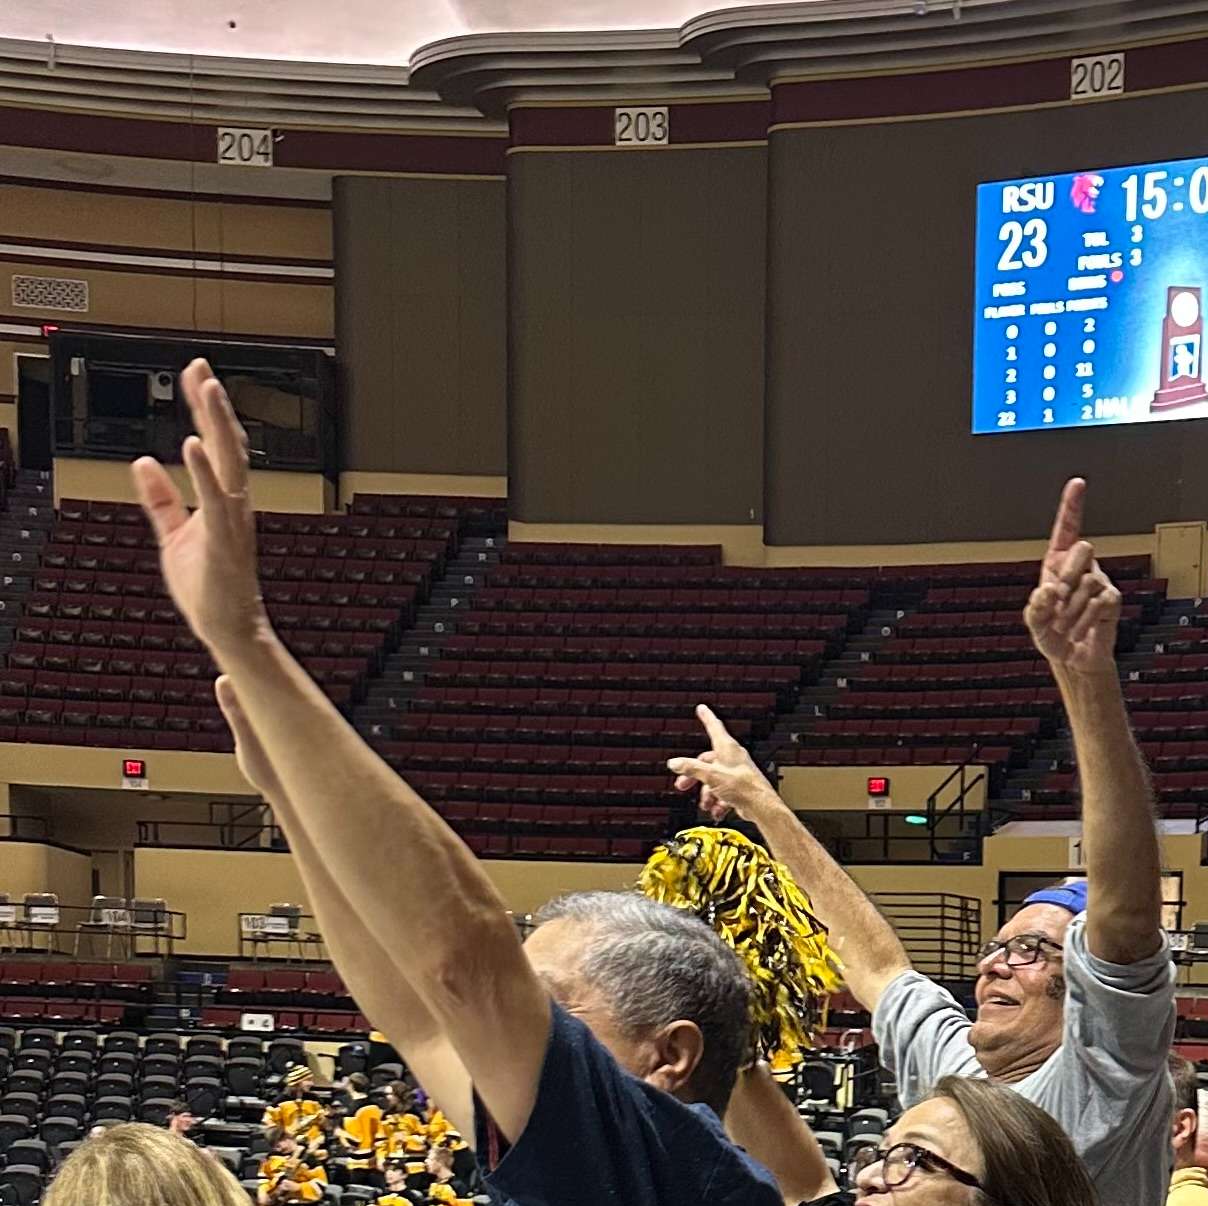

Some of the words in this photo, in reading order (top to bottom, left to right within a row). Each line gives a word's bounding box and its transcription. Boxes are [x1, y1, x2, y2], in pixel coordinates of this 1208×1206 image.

[1074, 59, 1121, 94] 202
[618, 112, 667, 142] 203
[221, 132, 270, 163] 204
[1003, 181, 1055, 213] RSU
[1131, 225, 1143, 243] 3
[998, 218, 1048, 271] 23
[1129, 248, 1142, 267] 3
[1083, 317, 1096, 333] 2
[1006, 345, 1018, 361] 1
[1005, 368, 1017, 383] 2
[1005, 389, 1017, 405] 3
[1081, 383, 1094, 399] 5
[1043, 408, 1054, 424] 1
[1080, 405, 1094, 420] 2
